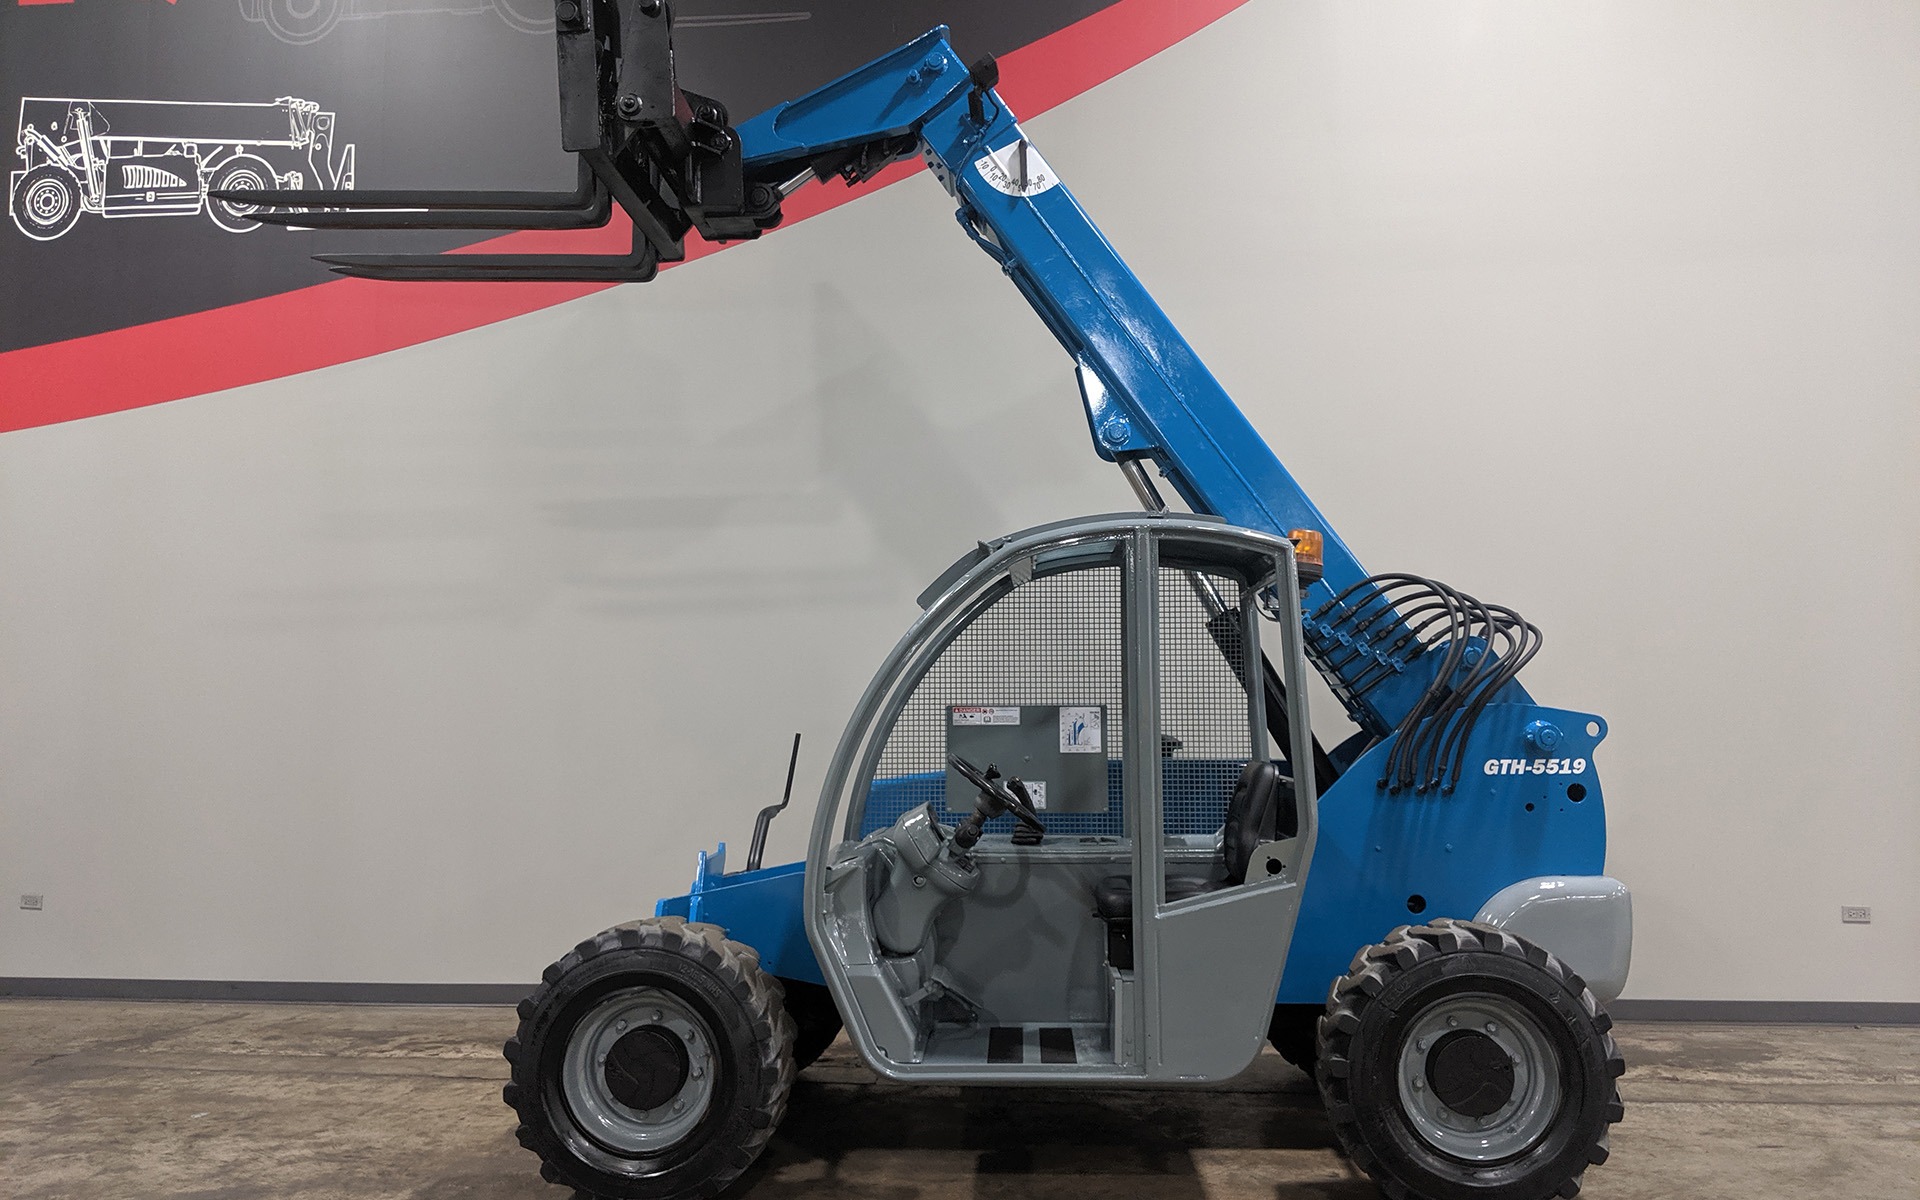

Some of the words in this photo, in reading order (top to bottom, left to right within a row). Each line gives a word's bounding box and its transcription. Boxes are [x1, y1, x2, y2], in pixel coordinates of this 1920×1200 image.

[990, 173, 998, 181] 10
[998, 172, 1007, 181] 20
[1003, 181, 1011, 190] 30
[1011, 178, 1019, 187] 40
[1033, 181, 1041, 190] 70
[1037, 174, 1045, 182] 80
[1483, 758, 1587, 775] GTH-5519
